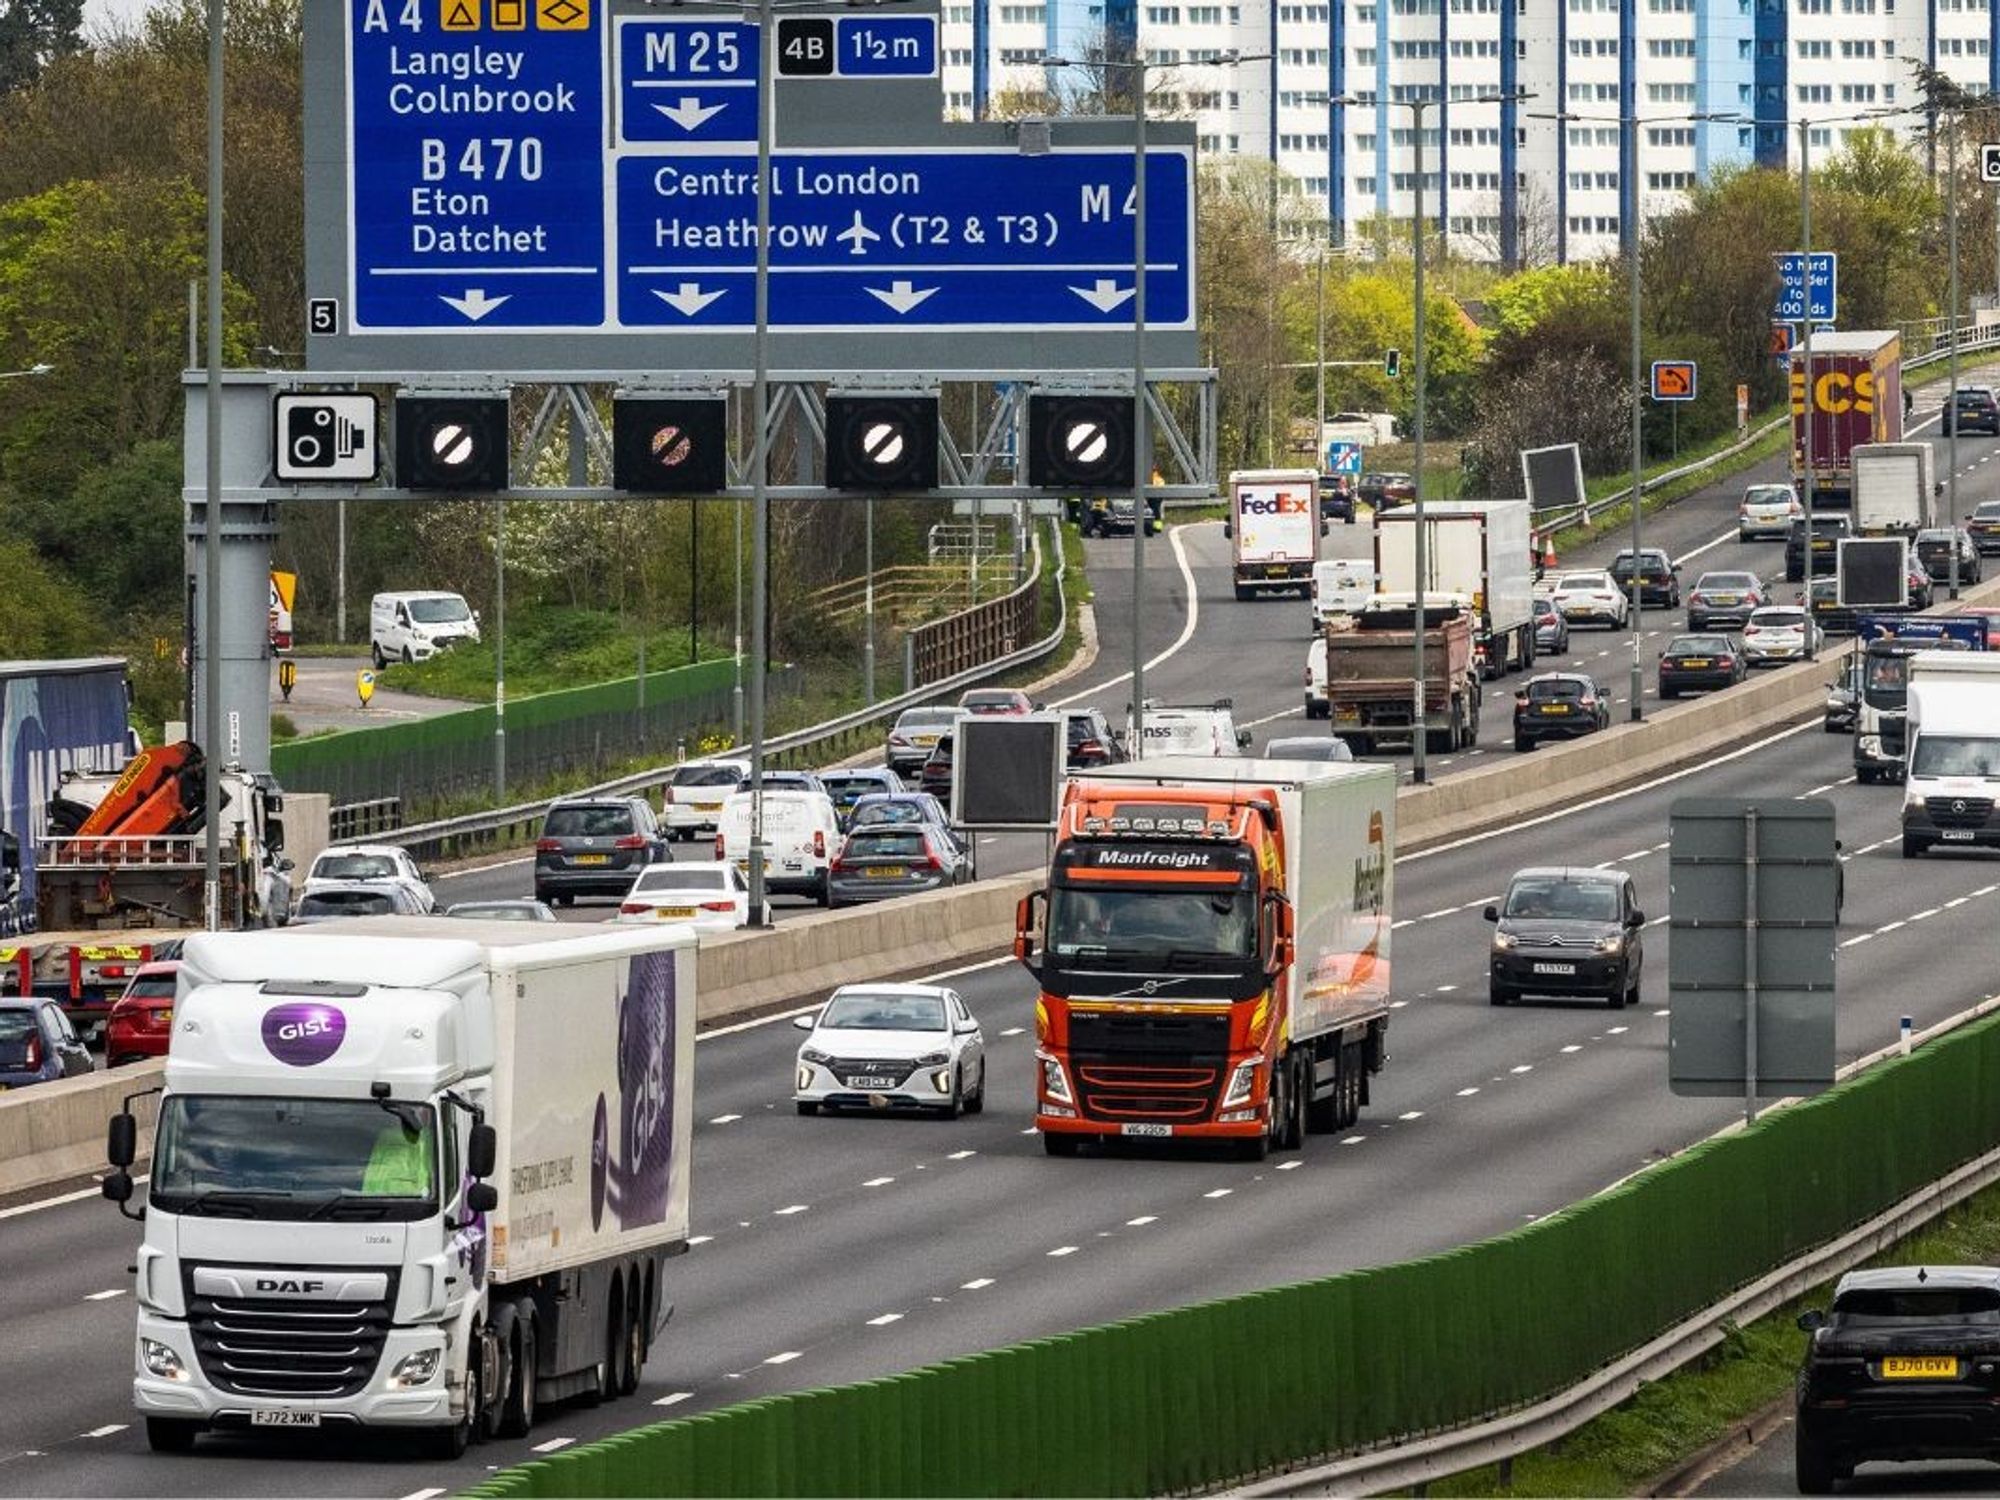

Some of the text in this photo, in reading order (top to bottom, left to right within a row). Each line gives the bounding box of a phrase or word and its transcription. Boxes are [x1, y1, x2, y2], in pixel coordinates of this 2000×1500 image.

[392, 46, 523, 79] Langley
[390, 83, 574, 113] Colnbrook
[799, 167, 918, 194] London
[413, 188, 488, 214] Eton
[414, 225, 546, 251] Datchet
[655, 213, 1057, 247] Heathrow (T2 & T3)
[316, 306, 330, 327] 5
[1240, 493, 1309, 515] FedEx
[1099, 851, 1210, 867] Manfreight
[256, 1280, 323, 1293] DAF
[1889, 1359, 1923, 1371] BJ70
[257, 1411, 288, 1424] FJ72
